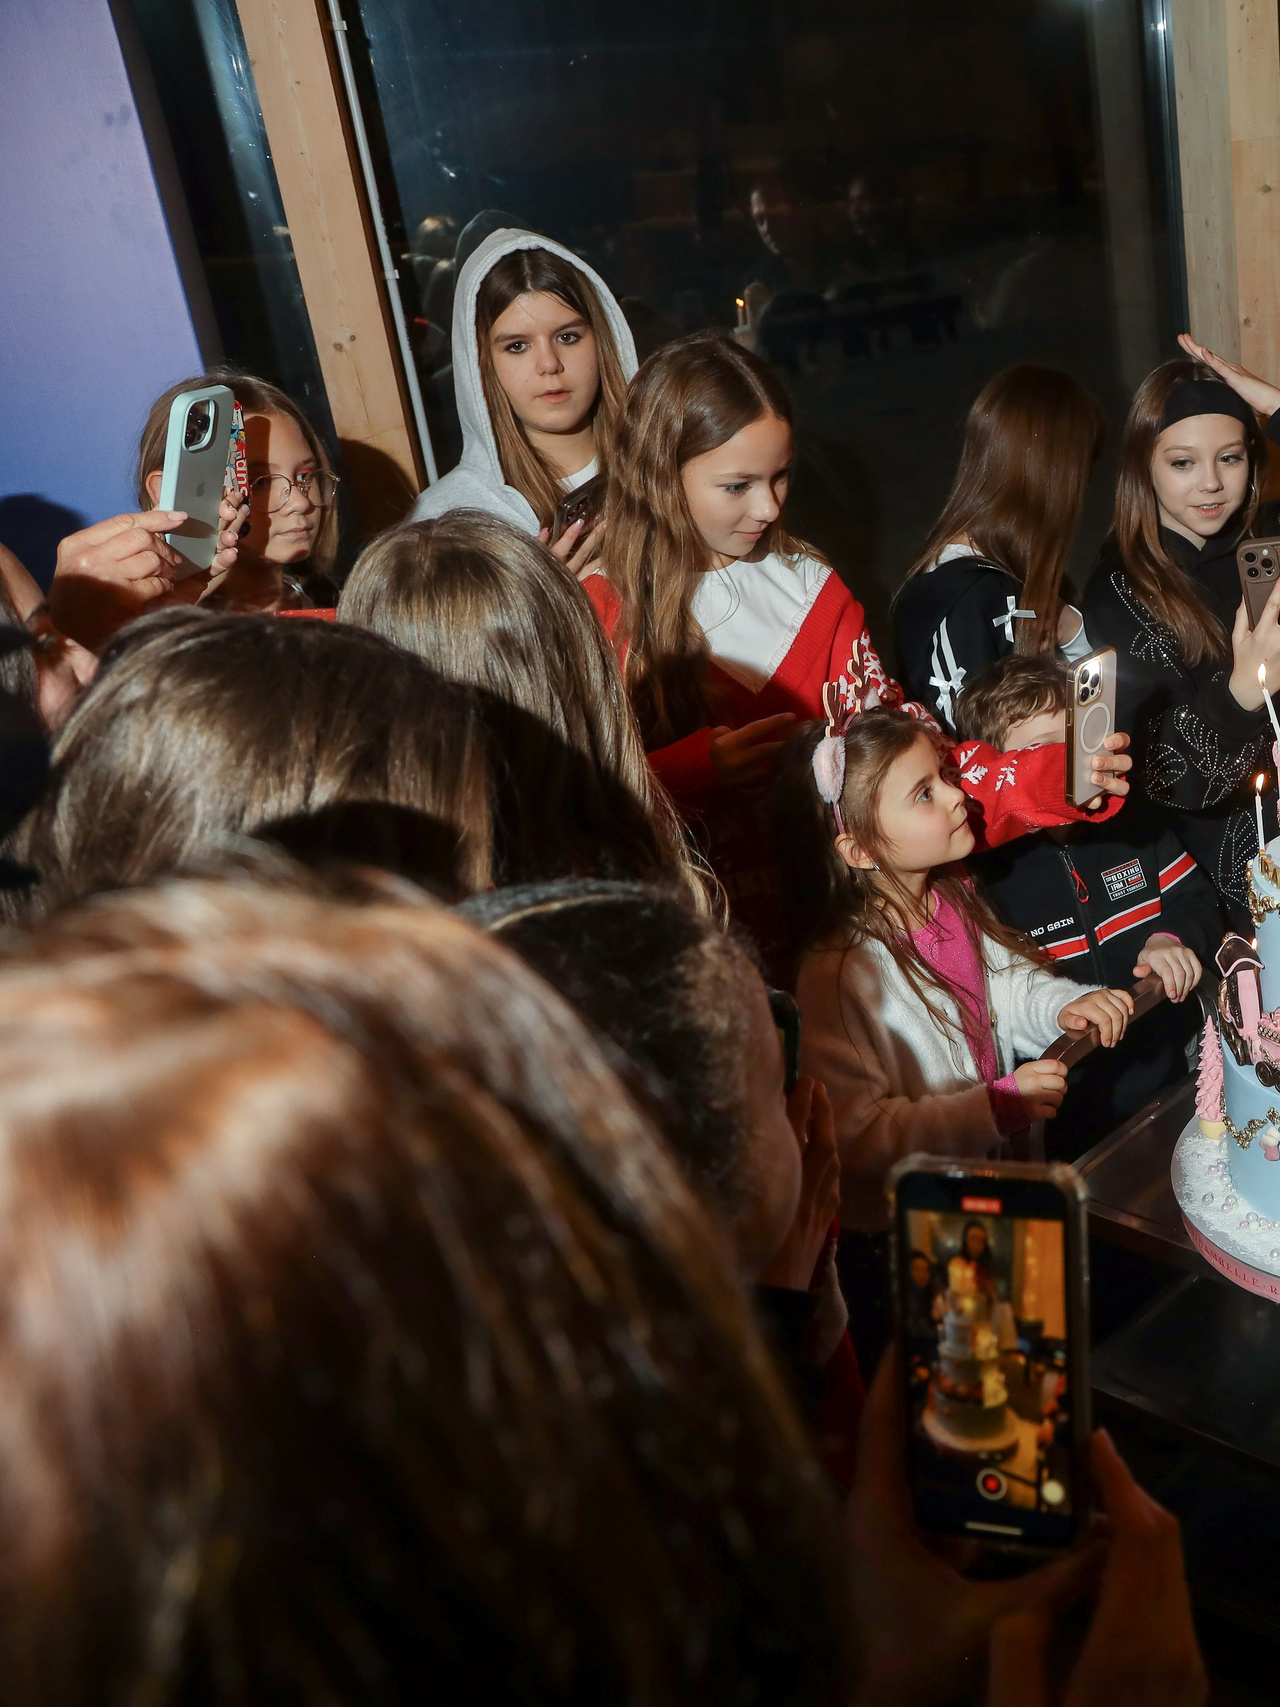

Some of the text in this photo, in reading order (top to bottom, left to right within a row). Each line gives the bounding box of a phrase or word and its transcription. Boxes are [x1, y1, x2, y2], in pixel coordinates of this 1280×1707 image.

[1111, 865, 1140, 882] BOXING
[1030, 927, 1045, 938] NO
[1046, 916, 1075, 932] GAIN
